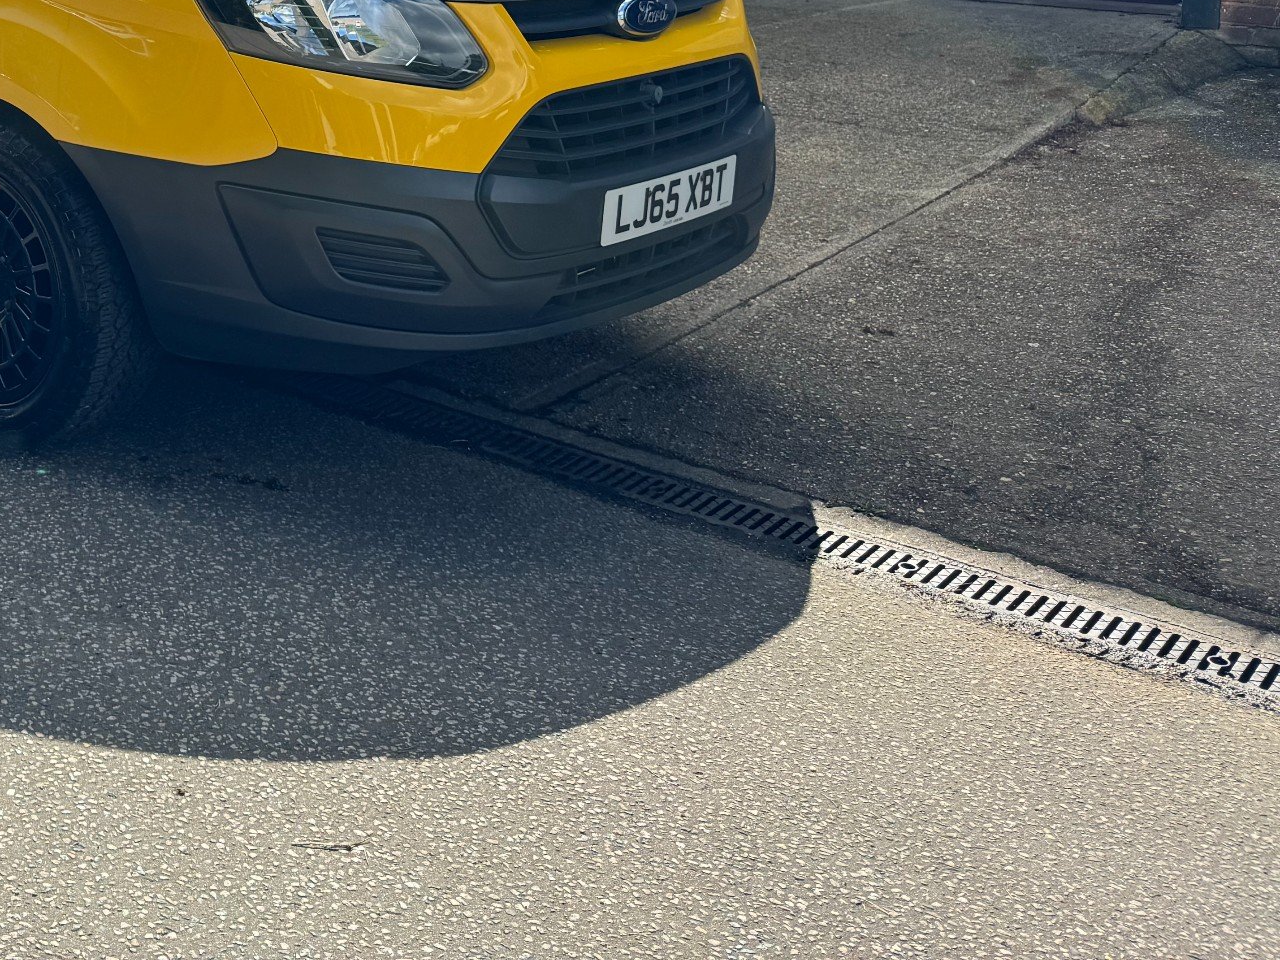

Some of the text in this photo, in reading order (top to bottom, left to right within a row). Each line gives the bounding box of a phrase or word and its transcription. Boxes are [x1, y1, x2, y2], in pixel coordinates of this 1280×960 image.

[637, 0, 669, 25] Ford
[614, 163, 728, 235] LJ65 XBT
